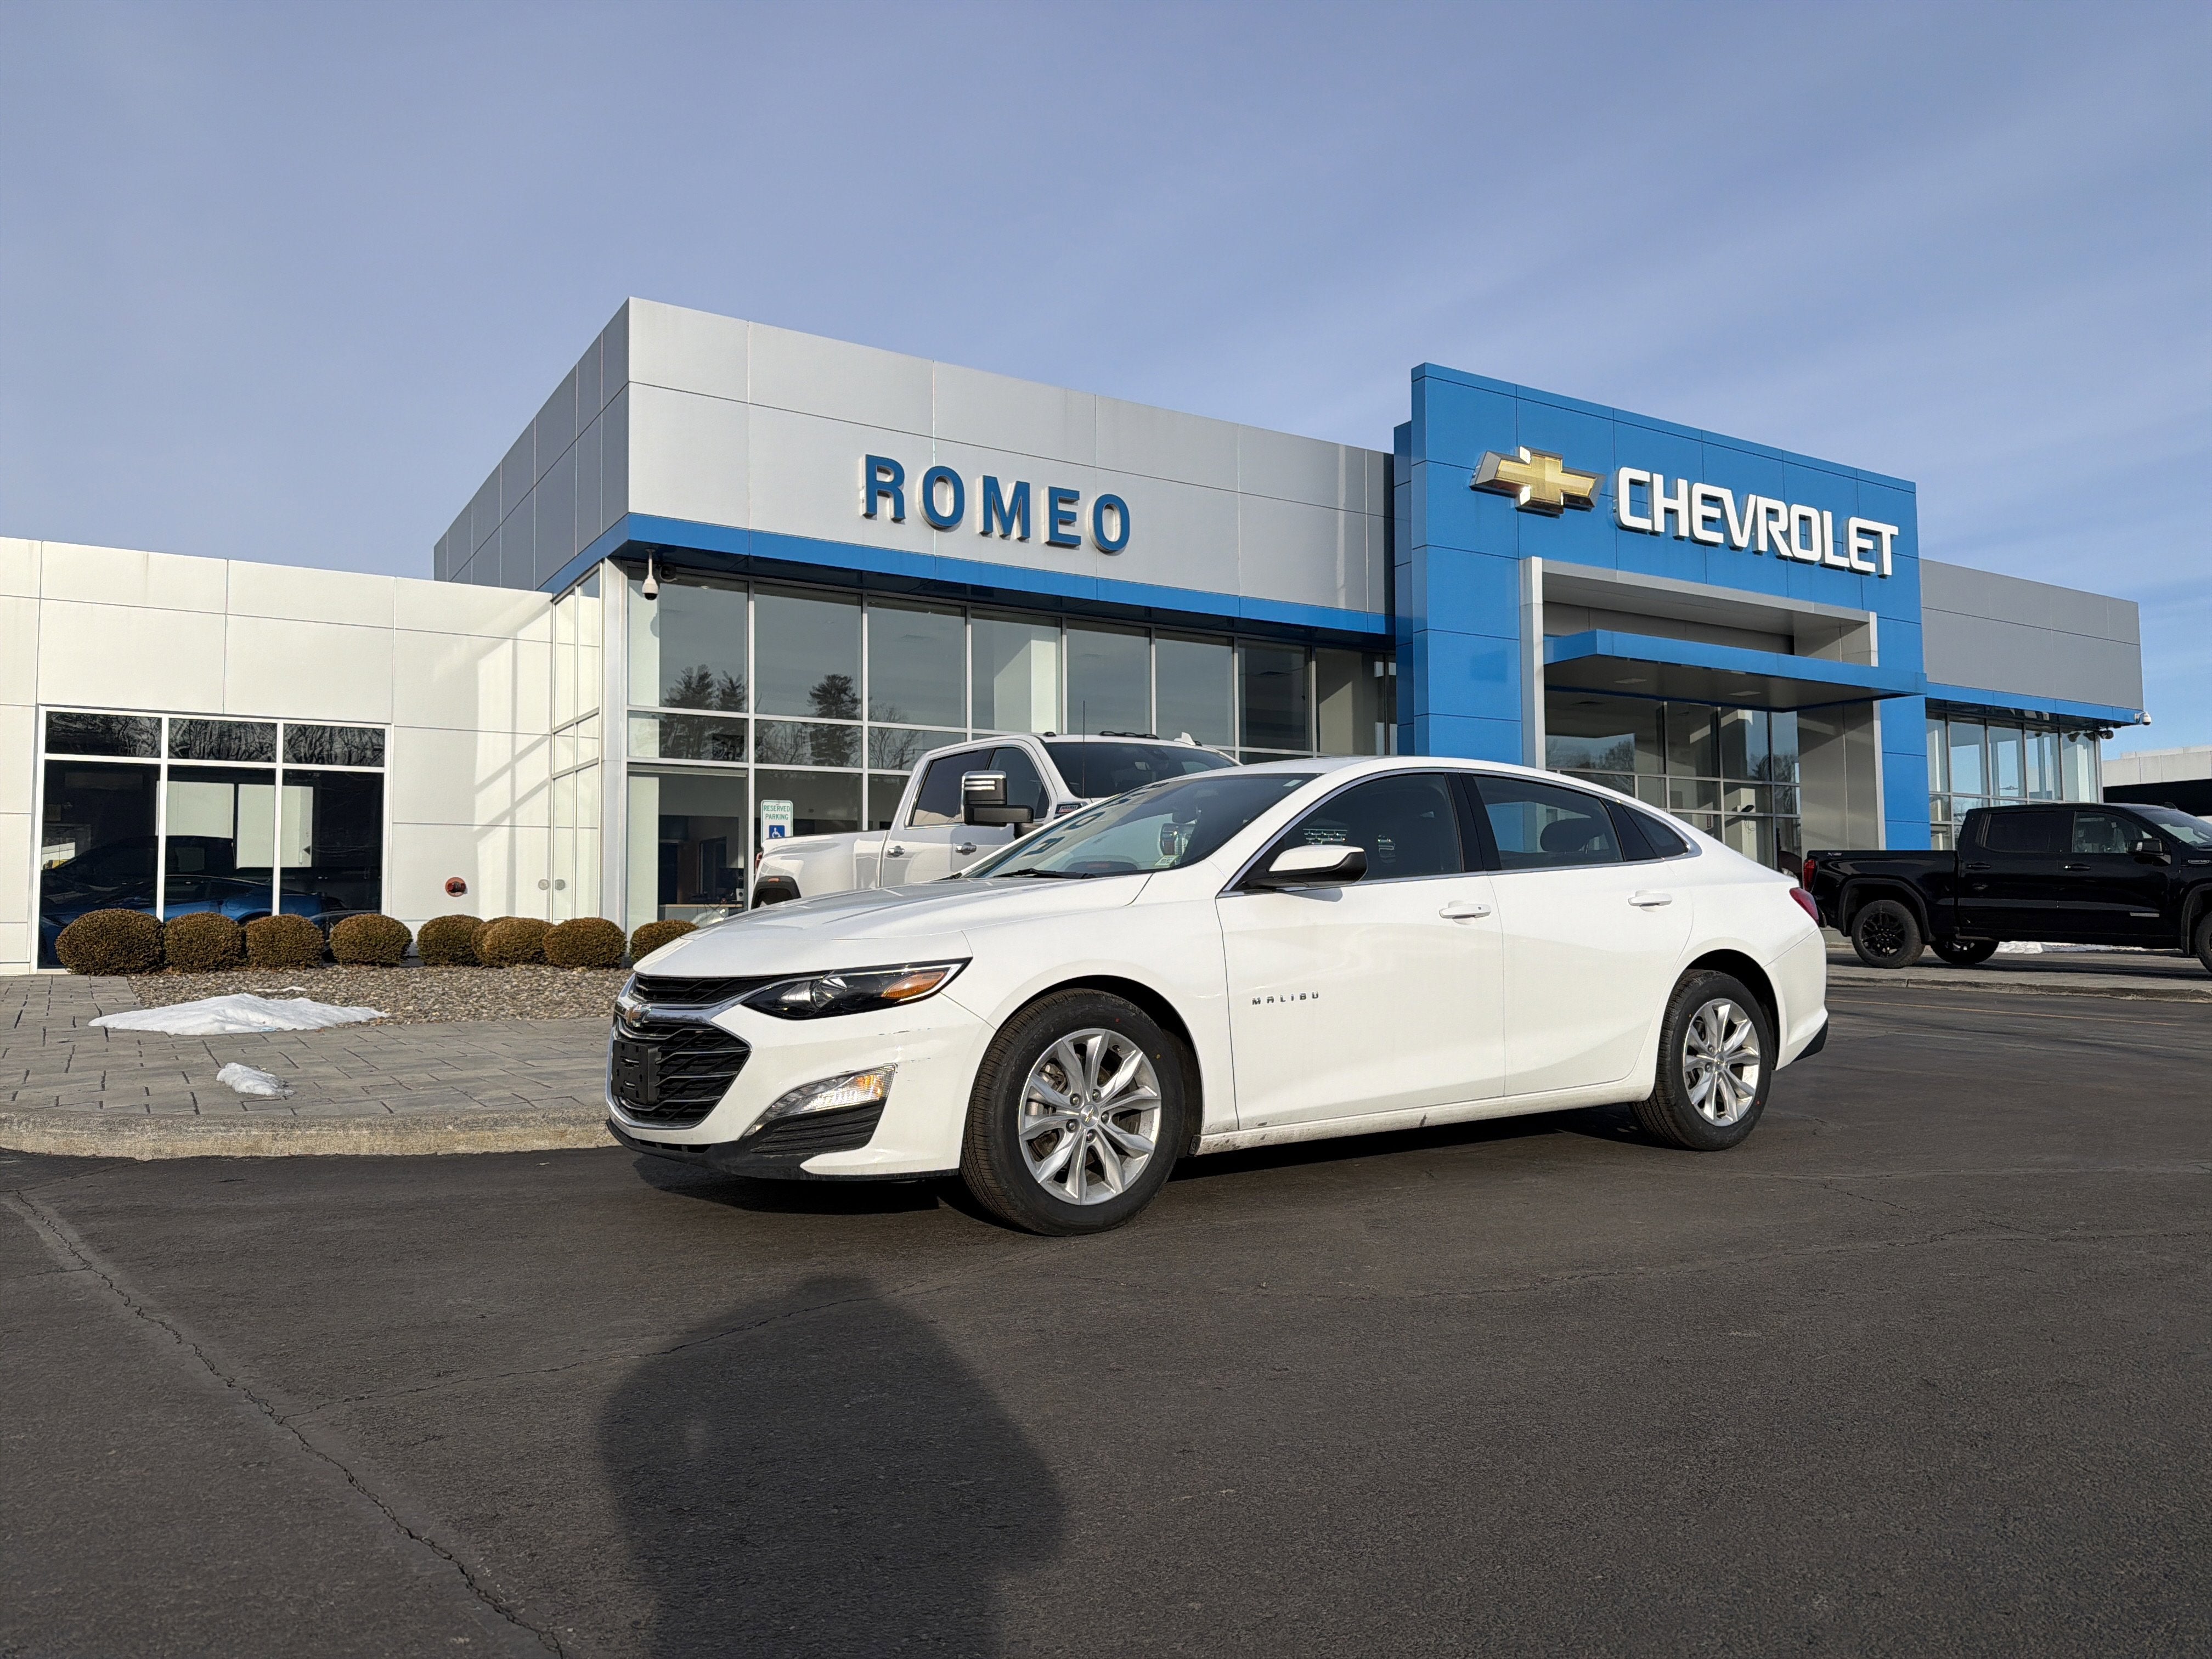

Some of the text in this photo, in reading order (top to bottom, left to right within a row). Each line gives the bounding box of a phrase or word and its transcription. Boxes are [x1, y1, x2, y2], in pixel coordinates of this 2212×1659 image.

[862, 454, 1130, 553] ROMEO
[1616, 466, 1899, 577] CHEVROLET
[1251, 991, 1319, 1005] MALIBU
